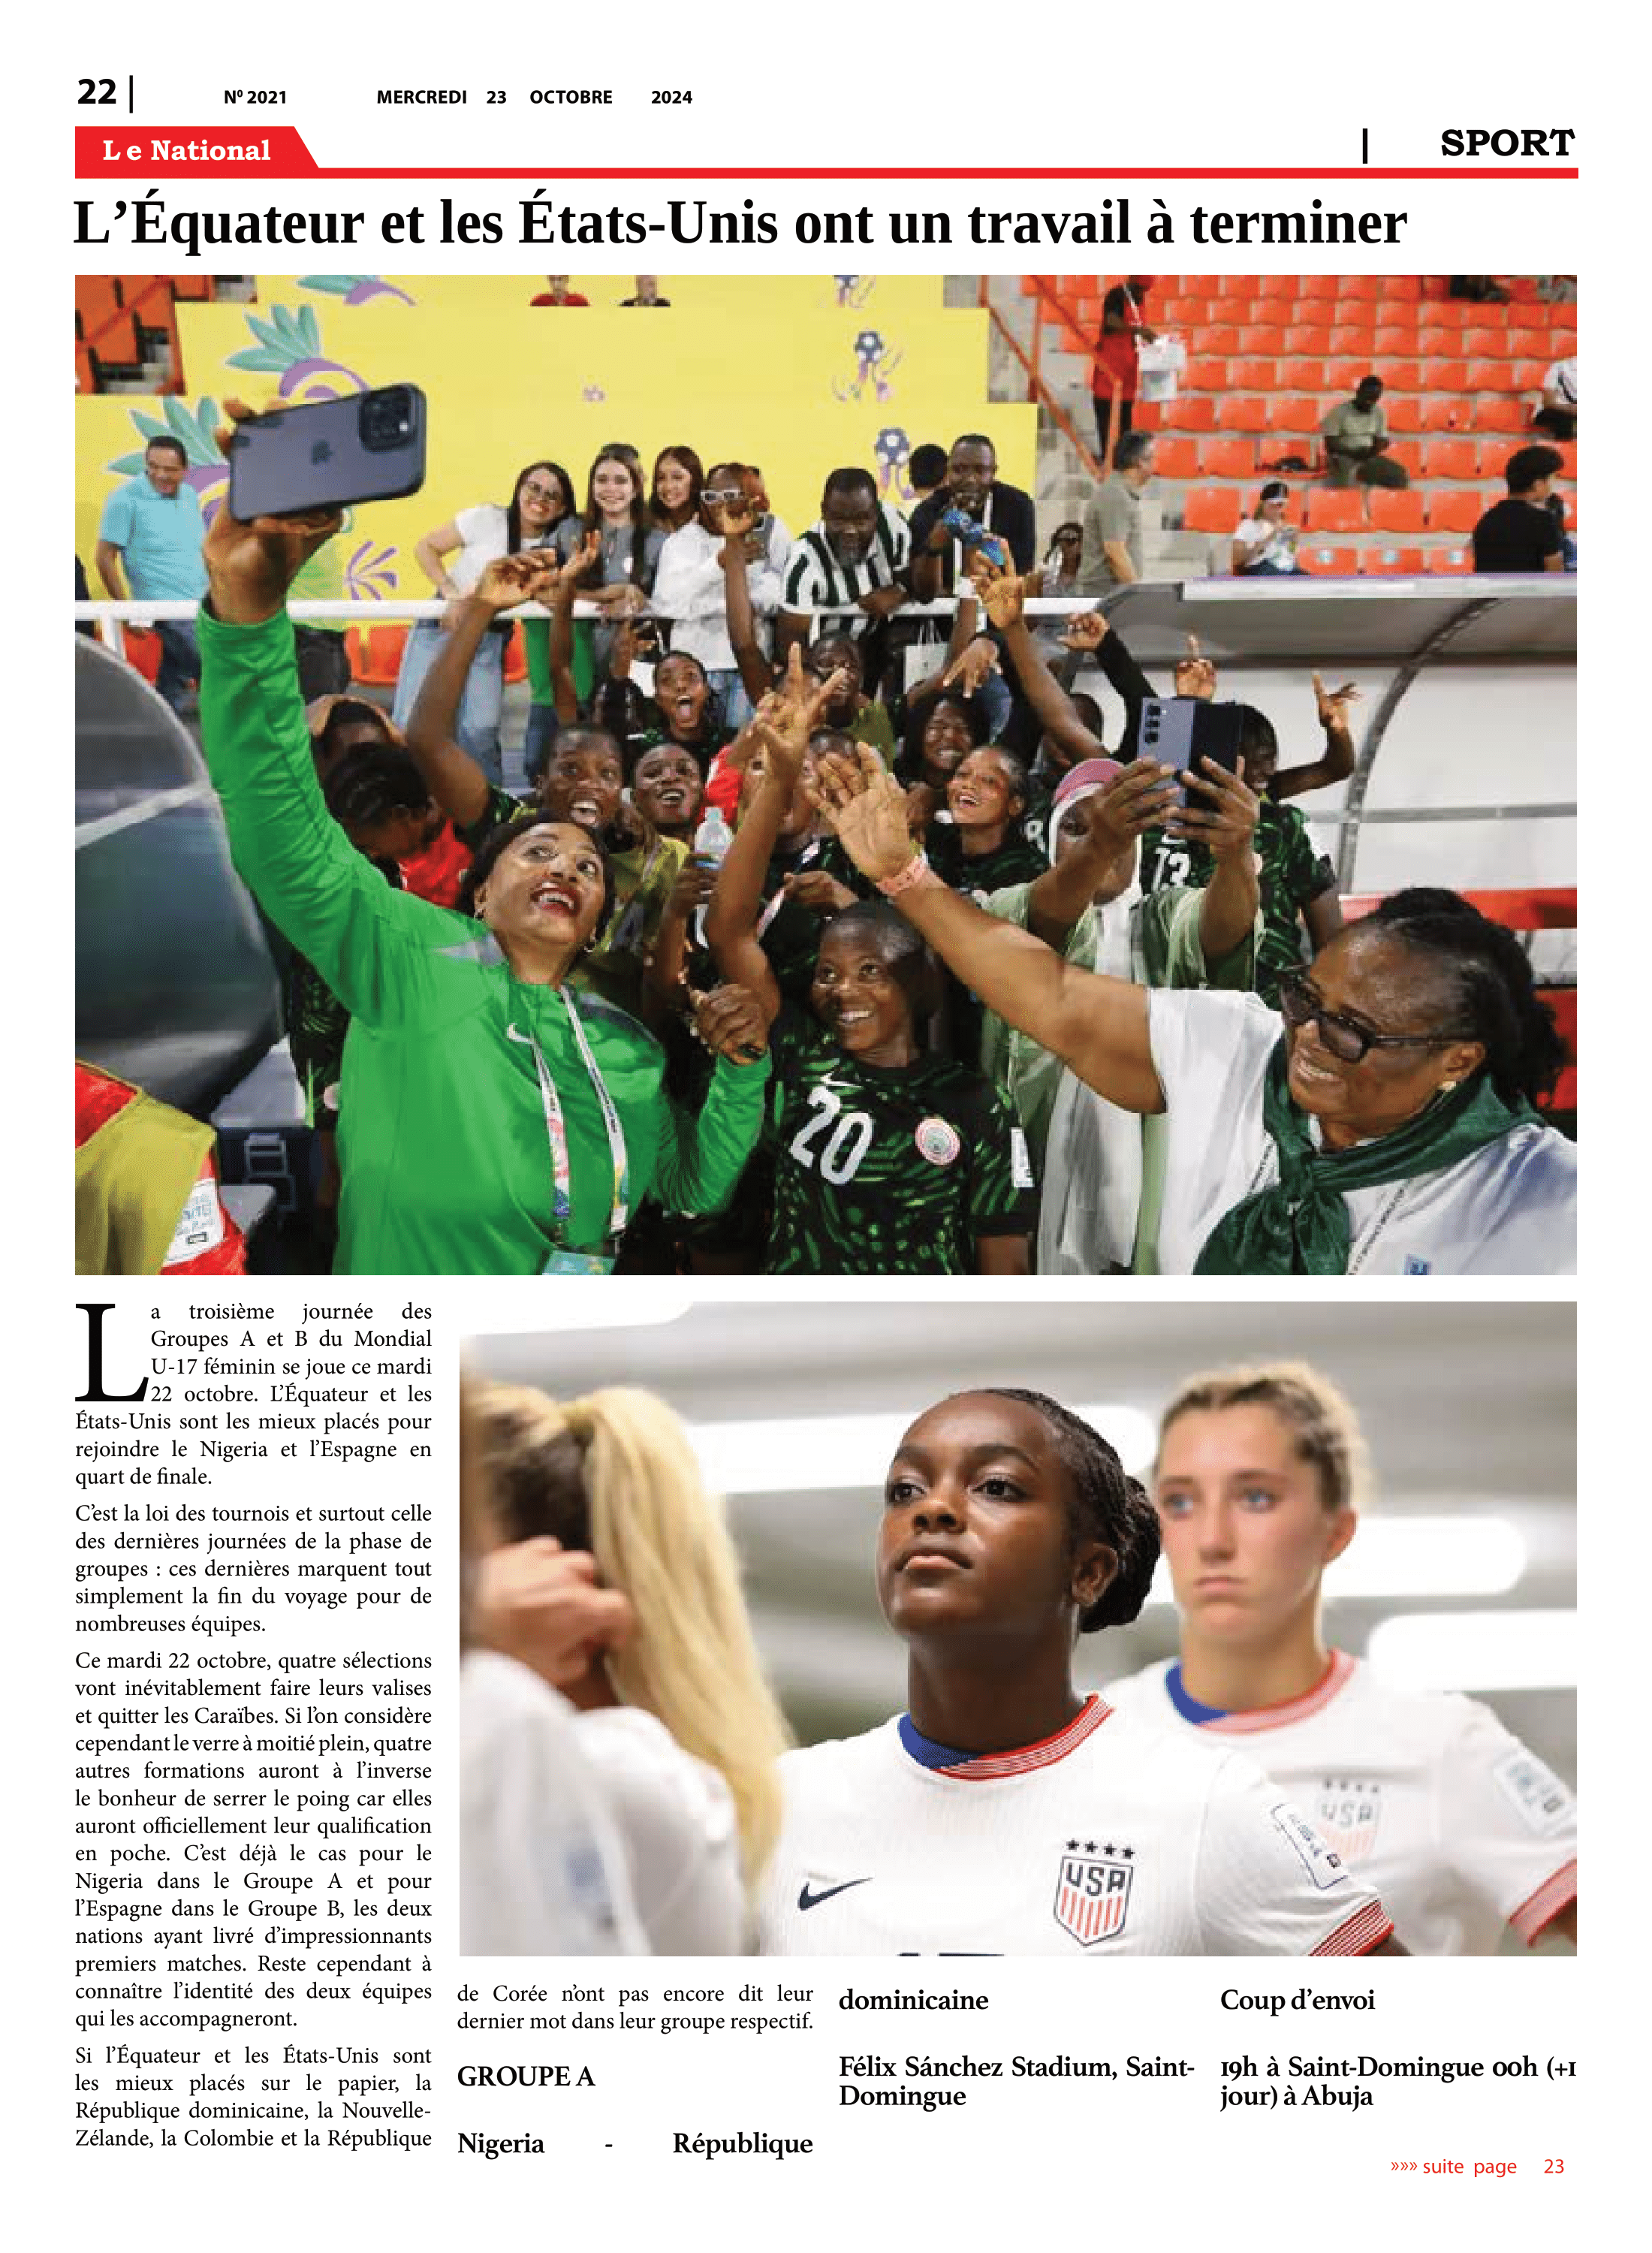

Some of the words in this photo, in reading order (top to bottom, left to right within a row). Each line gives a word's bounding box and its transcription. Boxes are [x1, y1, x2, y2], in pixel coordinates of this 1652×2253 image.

[77, 78, 116, 104] 22
[246, 90, 286, 104] 2021
[377, 89, 467, 104] MERCREDI
[486, 90, 507, 104] 23
[529, 89, 613, 104] OCTOBRE
[651, 90, 693, 104] 2024
[151, 139, 271, 161] National
[1441, 128, 1576, 157] SPORT
[73, 188, 365, 257] L’Équateur
[381, 207, 426, 244] et
[439, 198, 503, 244] les
[518, 188, 778, 244] États-Unis
[795, 207, 875, 244] ont
[888, 213, 953, 244] un
[967, 198, 1132, 244] travail
[1147, 198, 1175, 244] à
[1189, 198, 1408, 244] terminer
[788, 1085, 874, 1186] 20
[188, 1302, 275, 1320] troisième
[301, 1302, 373, 1325] journée
[402, 1301, 432, 1320] des
[151, 1330, 228, 1352] Groupes
[239, 1330, 256, 1347] A
[267, 1332, 284, 1347] et
[294, 1330, 308, 1347] B
[319, 1329, 343, 1347] du
[354, 1329, 433, 1347] Mondial
[150, 1358, 197, 1375] U-17
[203, 1356, 276, 1374] féminin
[282, 1362, 300, 1374] se
[305, 1358, 345, 1380] joue
[351, 1362, 371, 1374] ce
[376, 1356, 433, 1374] mardi
[151, 1386, 172, 1402] 22
[184, 1384, 258, 1402] octobre.
[270, 1382, 369, 1407] L’Équateur
[379, 1387, 396, 1402] et
[408, 1384, 432, 1402] les
[75, 1409, 171, 1430] États-Unis
[179, 1415, 219, 1429] sont
[225, 1411, 250, 1429] les
[258, 1413, 317, 1429] mieux
[324, 1411, 379, 1434] placés
[387, 1417, 433, 1434] pour
[75, 1439, 159, 1463] rejoindre
[171, 1439, 188, 1457] le
[200, 1440, 269, 1463] Nigeria
[281, 1442, 298, 1457] et
[309, 1439, 397, 1463] l’Espagne
[410, 1445, 433, 1457] en
[75, 1470, 125, 1490] quart
[130, 1467, 152, 1485] de
[157, 1467, 212, 1485] finale.
[75, 1586, 183, 1609] simplement
[192, 1586, 209, 1604] la
[218, 1586, 243, 1604] fin
[252, 1586, 276, 1604] du
[284, 1592, 348, 1609] voyage
[356, 1592, 402, 1609] pour
[410, 1586, 432, 1604] de
[75, 1614, 185, 1632] nombreuses
[191, 1615, 266, 1637] équipes.
[75, 1651, 101, 1669] Ce
[107, 1651, 162, 1669] mardi
[168, 1652, 190, 1669] 22
[197, 1651, 271, 1671] octobre,
[278, 1654, 336, 1674] quatre
[342, 1651, 432, 1669] sélections
[74, 1788, 91, 1806] le
[98, 1788, 177, 1806] bonheur
[184, 1788, 206, 1806] de
[213, 1794, 267, 1806] serrer
[273, 1788, 290, 1806] le
[297, 1790, 350, 1812] poing
[357, 1794, 386, 1806] car
[393, 1788, 432, 1806] elles
[1321, 1800, 1373, 1829] USA
[1066, 1861, 1126, 1897] USA
[75, 1899, 162, 1922] l’Espagne
[171, 1899, 214, 1917] dans
[223, 1899, 239, 1917] le
[248, 1899, 318, 1922] Groupe
[327, 1899, 345, 1919] B,
[354, 1899, 378, 1917] les
[387, 1899, 433, 1917] deux
[75, 1955, 156, 1977] premiers
[167, 1953, 246, 1971] matches.
[258, 1955, 306, 1971] Reste
[317, 1953, 412, 1977] cependant
[422, 1954, 433, 1971] à
[457, 1983, 479, 2001] de
[493, 1984, 547, 2002] Corée
[561, 1983, 605, 2001] n’ont
[618, 1989, 649, 2007] pas
[663, 1989, 725, 2001] encore
[738, 1983, 764, 2001] dit
[776, 1983, 814, 2001] leur
[839, 1988, 989, 2010] dominicaine
[1220, 1989, 1286, 2017] Coup
[1291, 1988, 1376, 2010] d’envoi
[457, 2011, 525, 2029] dernier
[529, 2014, 567, 2029] mot
[571, 2011, 614, 2029] dans
[620, 2011, 656, 2029] leur
[660, 2017, 725, 2034] groupe
[730, 2011, 813, 2034] respectif.
[75, 2046, 92, 2064] Si
[106, 2043, 201, 2069] l’Équateur
[214, 2049, 231, 2064] et
[245, 2046, 269, 2064] les
[283, 2043, 378, 2064] États-Unis
[393, 2049, 432, 2064] sont
[839, 2055, 897, 2077] Félix
[905, 2055, 1003, 2077] Sánchez
[1011, 2055, 1117, 2081] Stadium,
[1126, 2055, 1195, 2077] Saint-
[457, 2065, 571, 2087] GROUPE
[575, 2065, 596, 2086] A
[1266, 2055, 1281, 2077] à
[1288, 2055, 1485, 2083] Saint-Domingue
[839, 2085, 966, 2113] Domingue
[1219, 2085, 1278, 2113] jour)
[1283, 2084, 1298, 2106] à
[1301, 2083, 1374, 2113] Abuja
[75, 2101, 180, 2124] République
[188, 2101, 309, 2121] dominicaine,
[318, 2101, 334, 2119] la
[342, 2101, 431, 2119] Nouvelle-
[75, 2128, 154, 2149] Zélande,
[161, 2128, 177, 2146] la
[184, 2128, 274, 2146] Colombie
[281, 2131, 297, 2146] et
[304, 2128, 321, 2146] la
[327, 2128, 432, 2152] République
[457, 2132, 546, 2160] Nigeria
[673, 2131, 813, 2161] République
[1423, 2158, 1464, 2174] suite
[1474, 2162, 1517, 2178] page
[1544, 2158, 1564, 2174] 23
